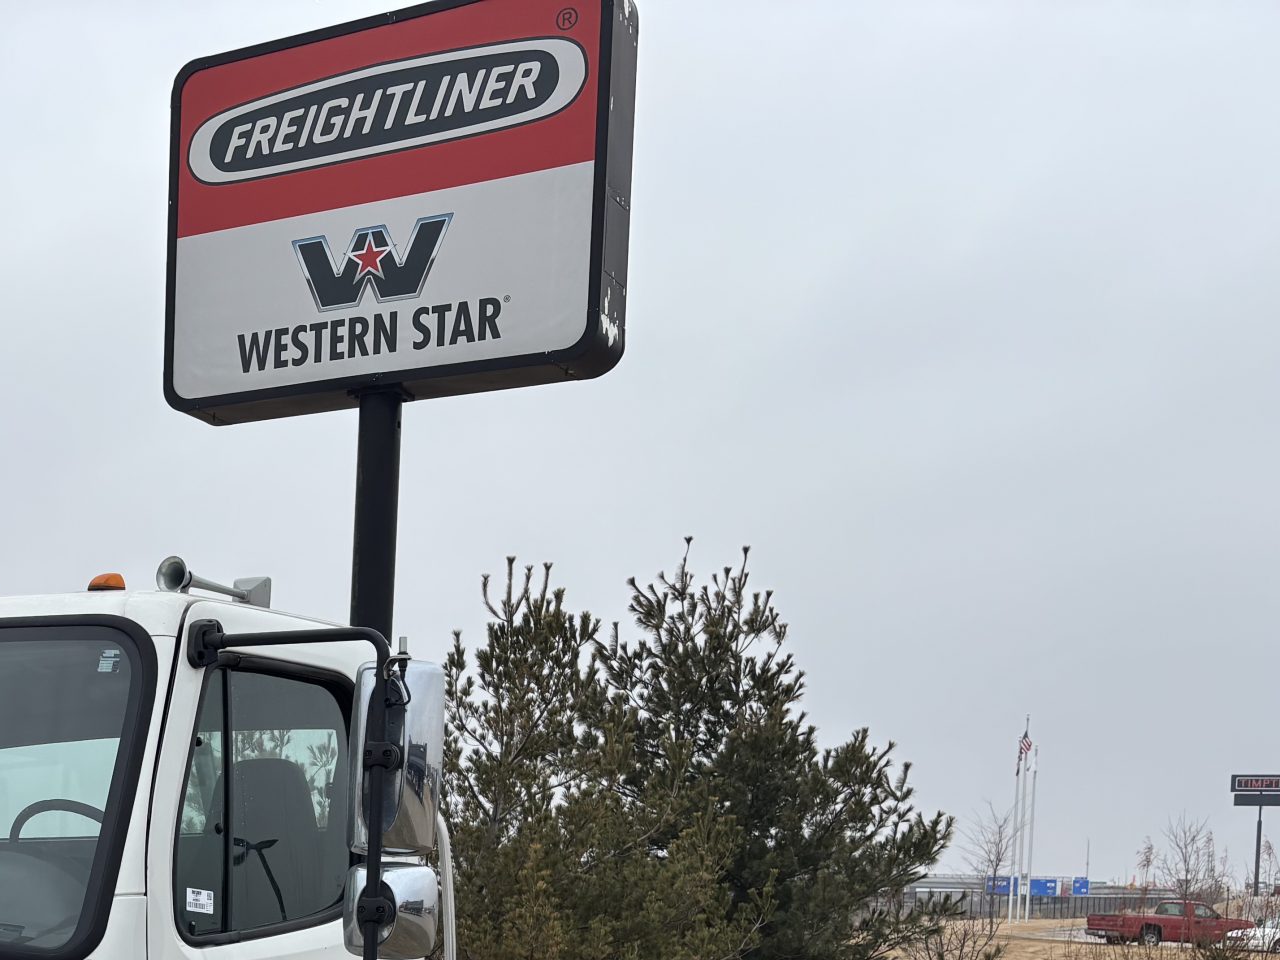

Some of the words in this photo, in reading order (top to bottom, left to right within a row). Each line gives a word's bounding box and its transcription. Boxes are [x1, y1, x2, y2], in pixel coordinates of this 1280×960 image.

[224, 61, 542, 164] FREIGHTLINER
[237, 311, 399, 375] WESTERN
[412, 297, 502, 351] STAR
[1240, 779, 1280, 789] TIMPT
